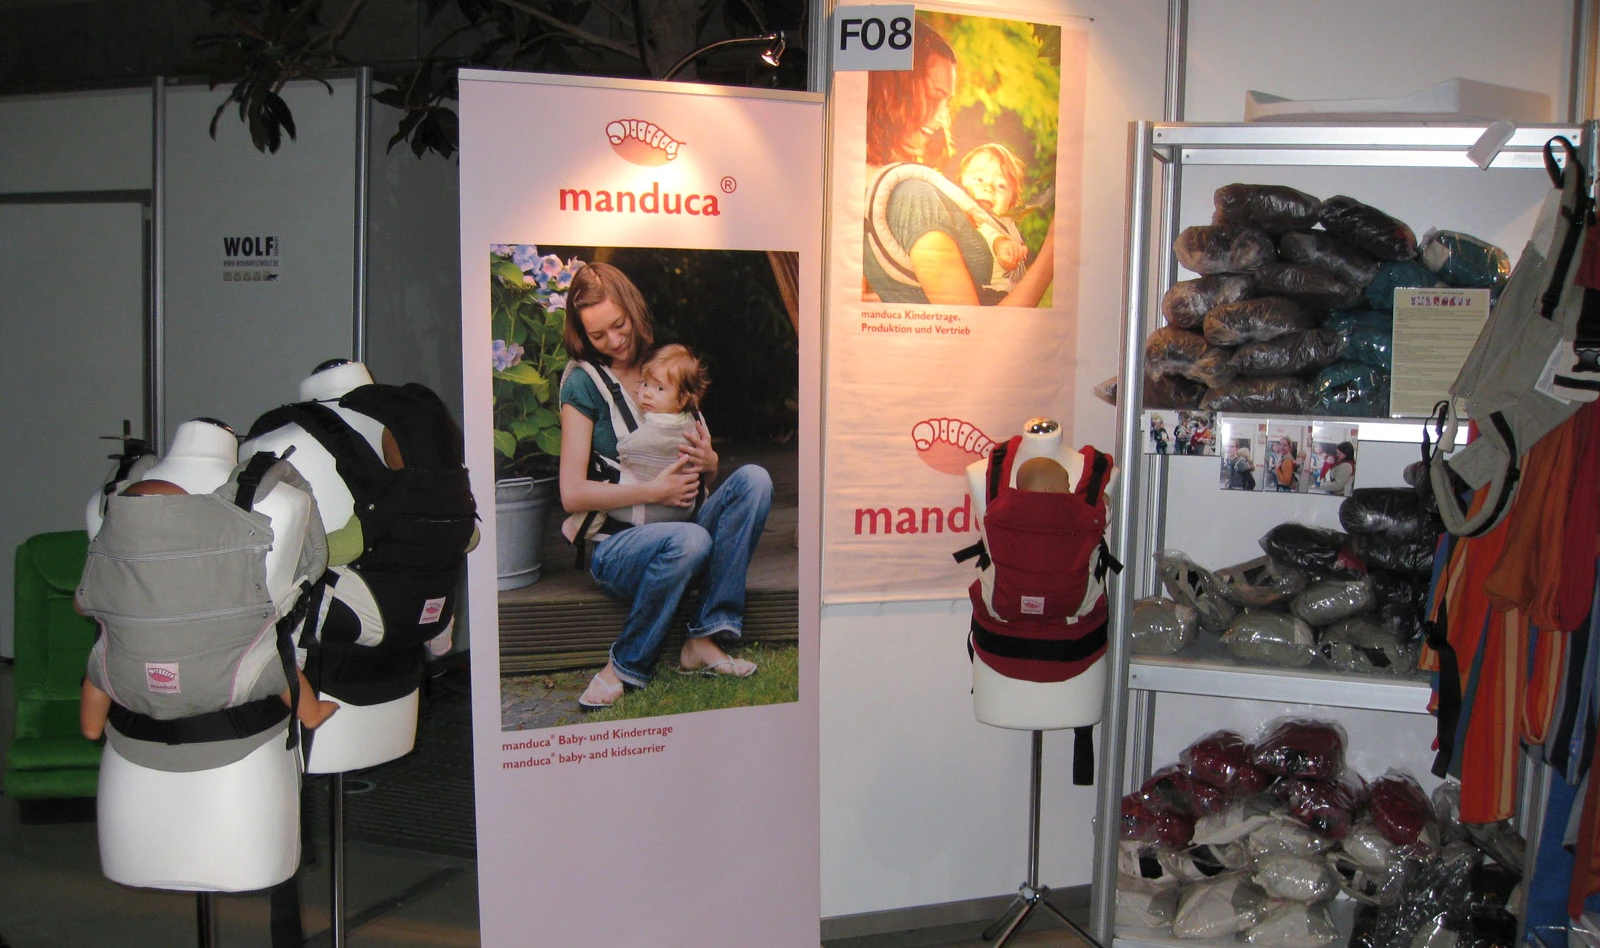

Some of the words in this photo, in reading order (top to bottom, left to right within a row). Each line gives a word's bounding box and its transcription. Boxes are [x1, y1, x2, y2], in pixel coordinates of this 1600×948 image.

[840, 17, 912, 51] F08
[223, 236, 274, 257] WOLF
[861, 310, 902, 320] manduca
[861, 323, 912, 334] Produktion
[915, 325, 932, 334] und
[935, 325, 971, 335] Vertrieb
[558, 734, 587, 746] Baby-
[590, 730, 609, 742] und
[613, 725, 673, 739] Kindertrage
[559, 753, 586, 764] baby-
[589, 749, 608, 760] and
[611, 743, 665, 758] kidscarrier
